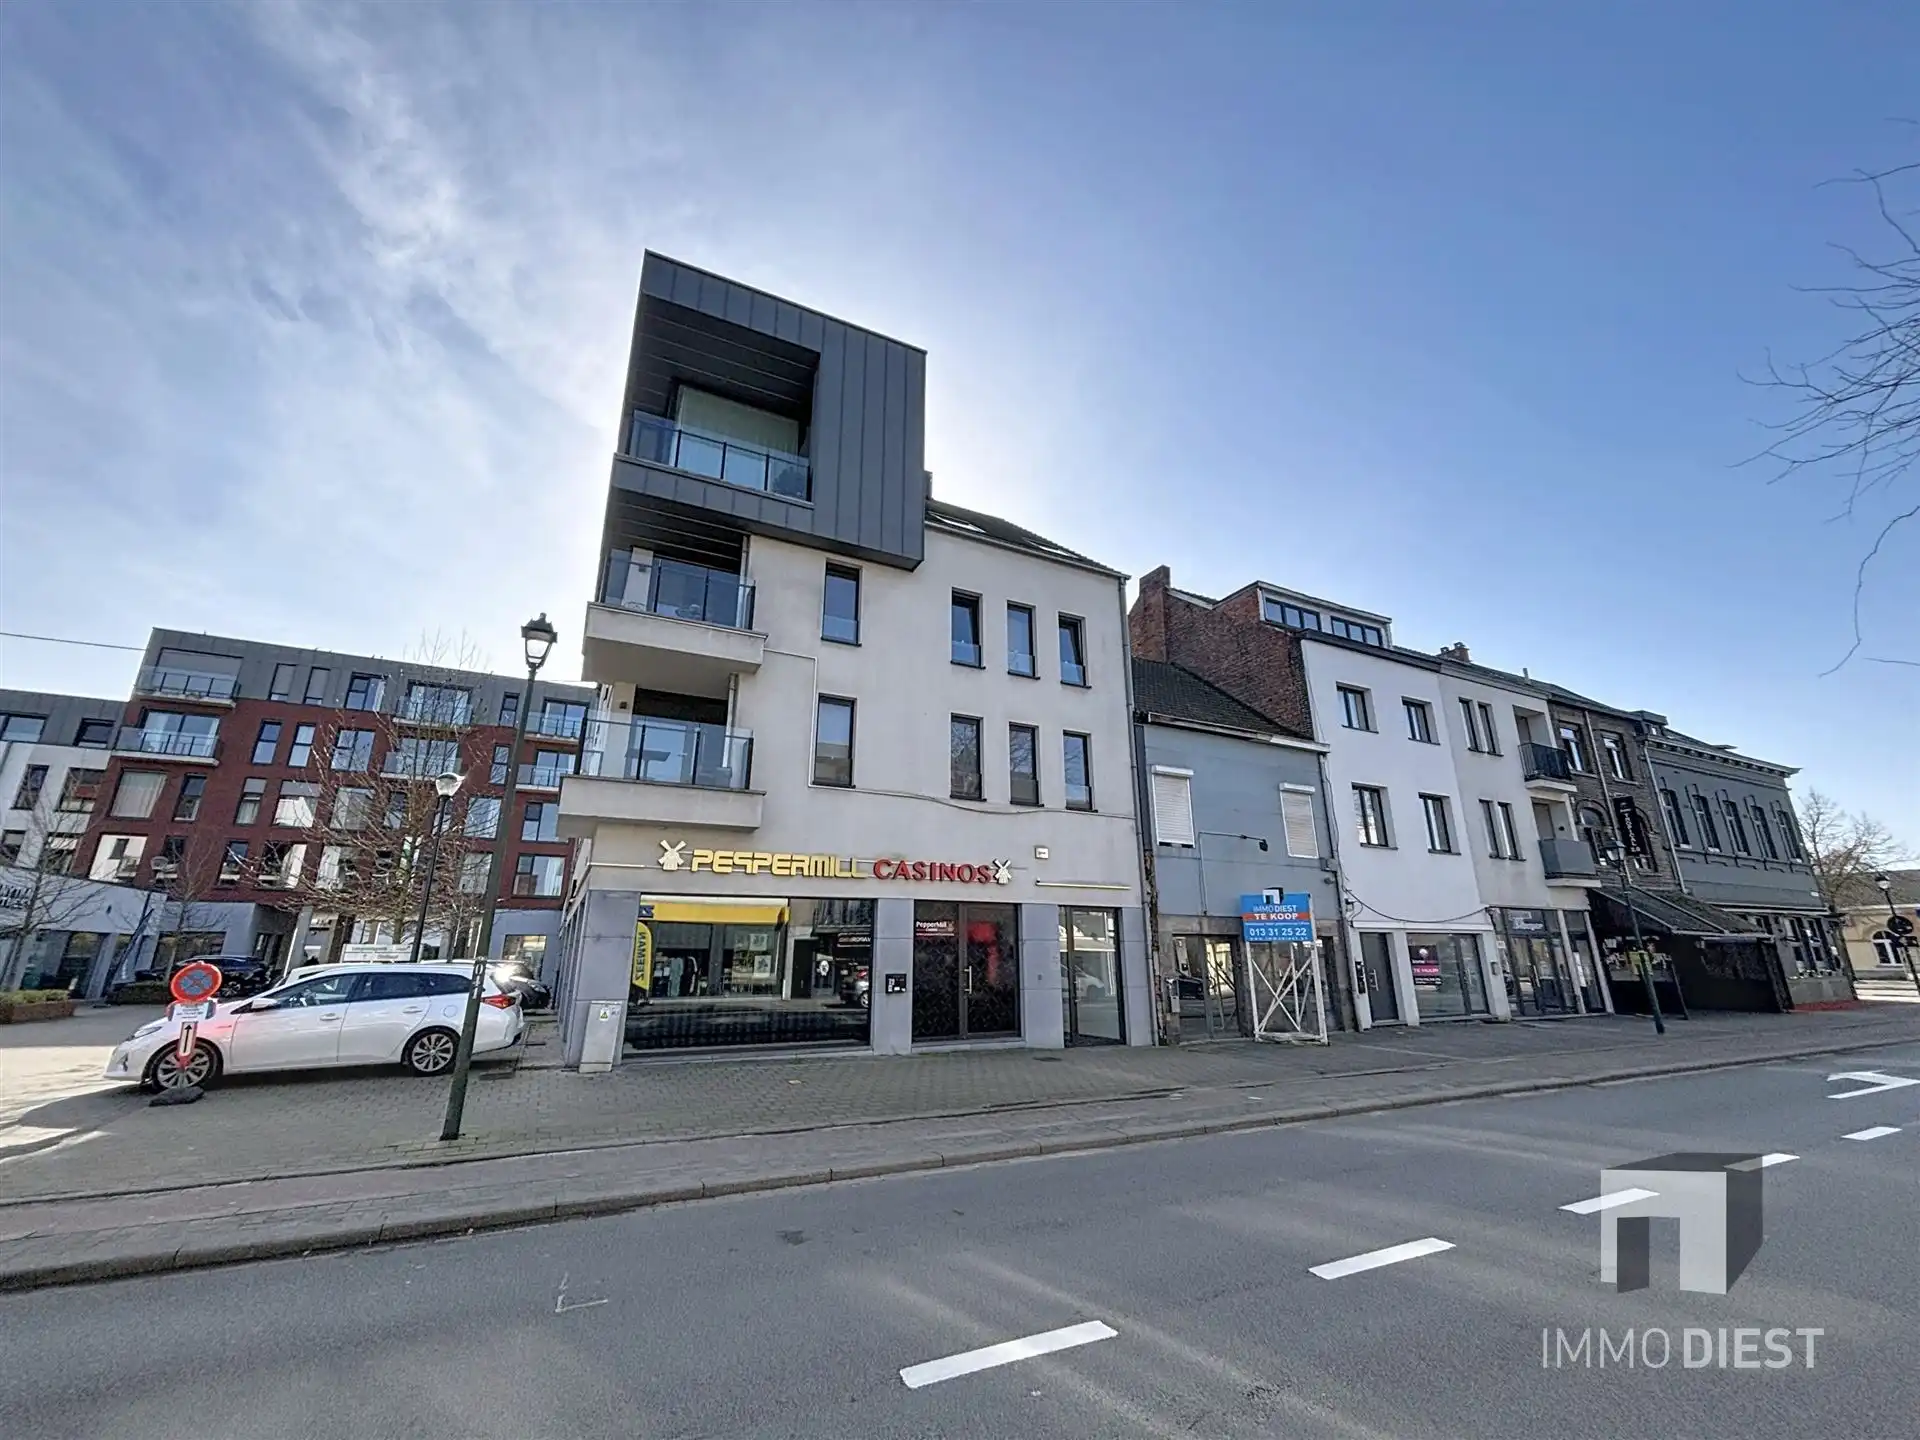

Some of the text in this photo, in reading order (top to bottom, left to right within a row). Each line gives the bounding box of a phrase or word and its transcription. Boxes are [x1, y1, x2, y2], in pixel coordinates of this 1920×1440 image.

[691, 849, 991, 884] PEPPERMILL CASINOS
[1253, 904, 1298, 913] IMMO DIEST
[1270, 912, 1299, 920] KOOP
[1249, 927, 1307, 936] 013 31 25 22
